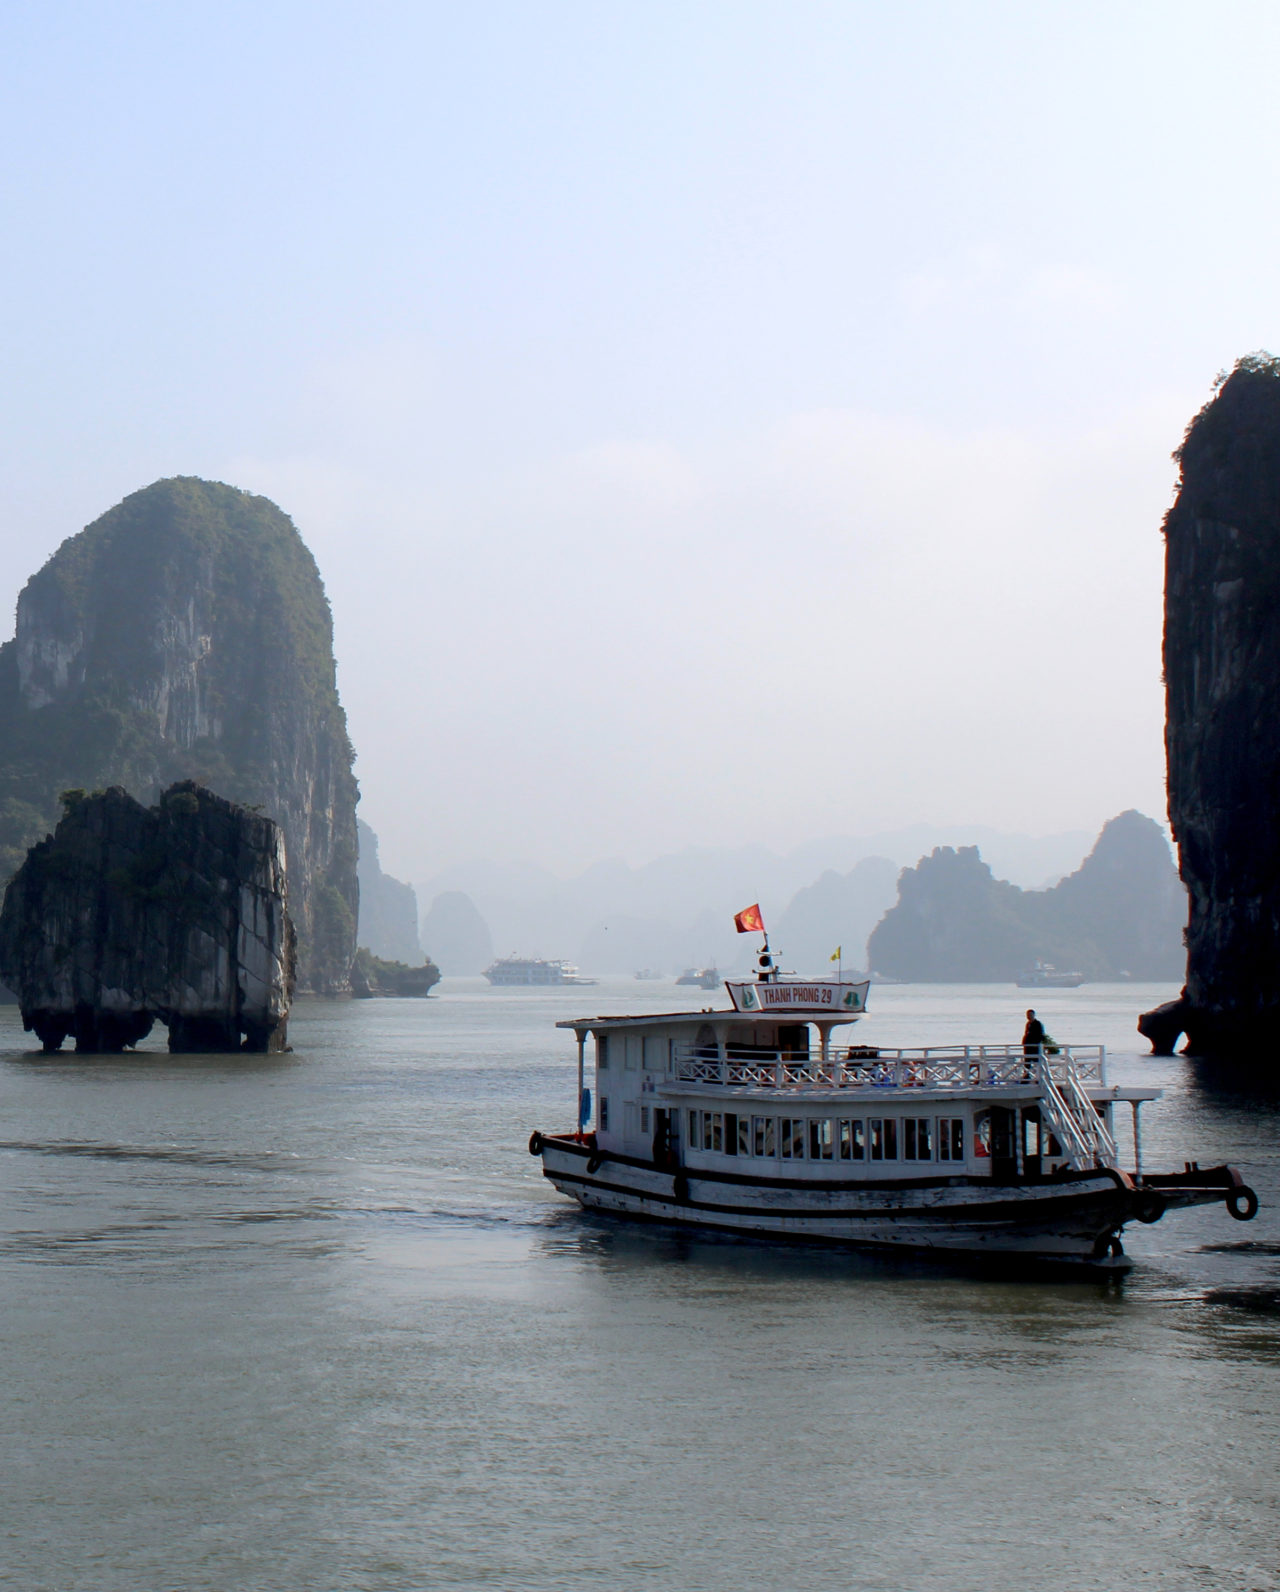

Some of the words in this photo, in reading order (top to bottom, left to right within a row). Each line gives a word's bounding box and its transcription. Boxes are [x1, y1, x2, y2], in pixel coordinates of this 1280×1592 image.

[764, 988, 791, 1003] THANH
[793, 988, 819, 1002] PHONG
[821, 989, 832, 1003] 29
